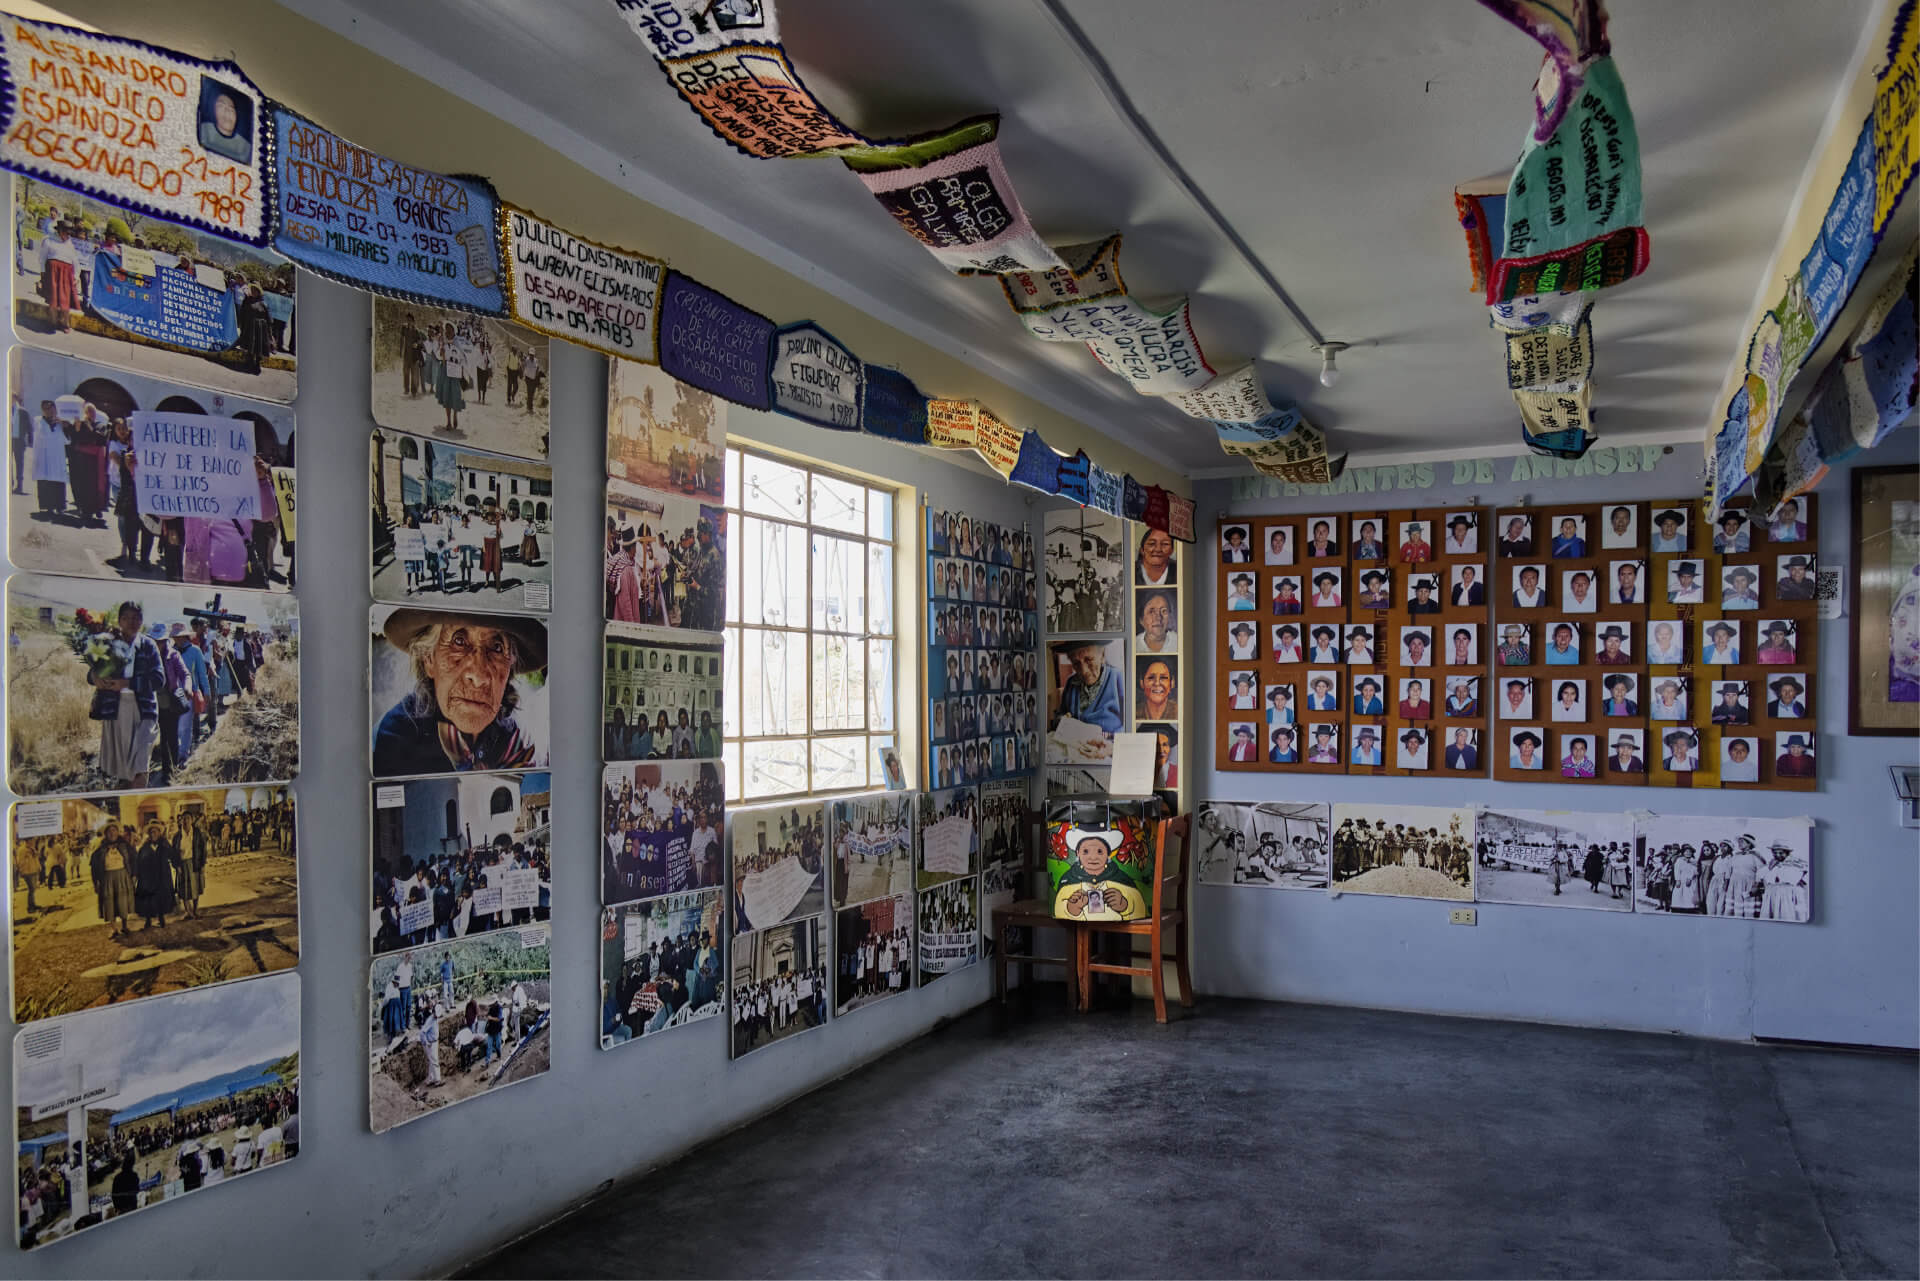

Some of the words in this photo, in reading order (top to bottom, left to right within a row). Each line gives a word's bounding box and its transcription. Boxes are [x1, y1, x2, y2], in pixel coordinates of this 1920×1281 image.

[16, 24, 187, 97] ALEJANDRO
[21, 87, 156, 150] ESPINOZA
[9, 121, 182, 196] ASESINADO
[287, 156, 378, 215] MENDOZA
[965, 181, 1006, 237] OLGA
[688, 314, 703, 336] DE
[724, 332, 753, 354] CRUZ
[144, 452, 167, 469] LEY
[176, 453, 194, 470] DE
[203, 454, 243, 476] BANCO
[229, 430, 247, 451] LA
[144, 473, 162, 490] DE
[174, 473, 210, 493] DATOS
[1452, 458, 1494, 485] DE
